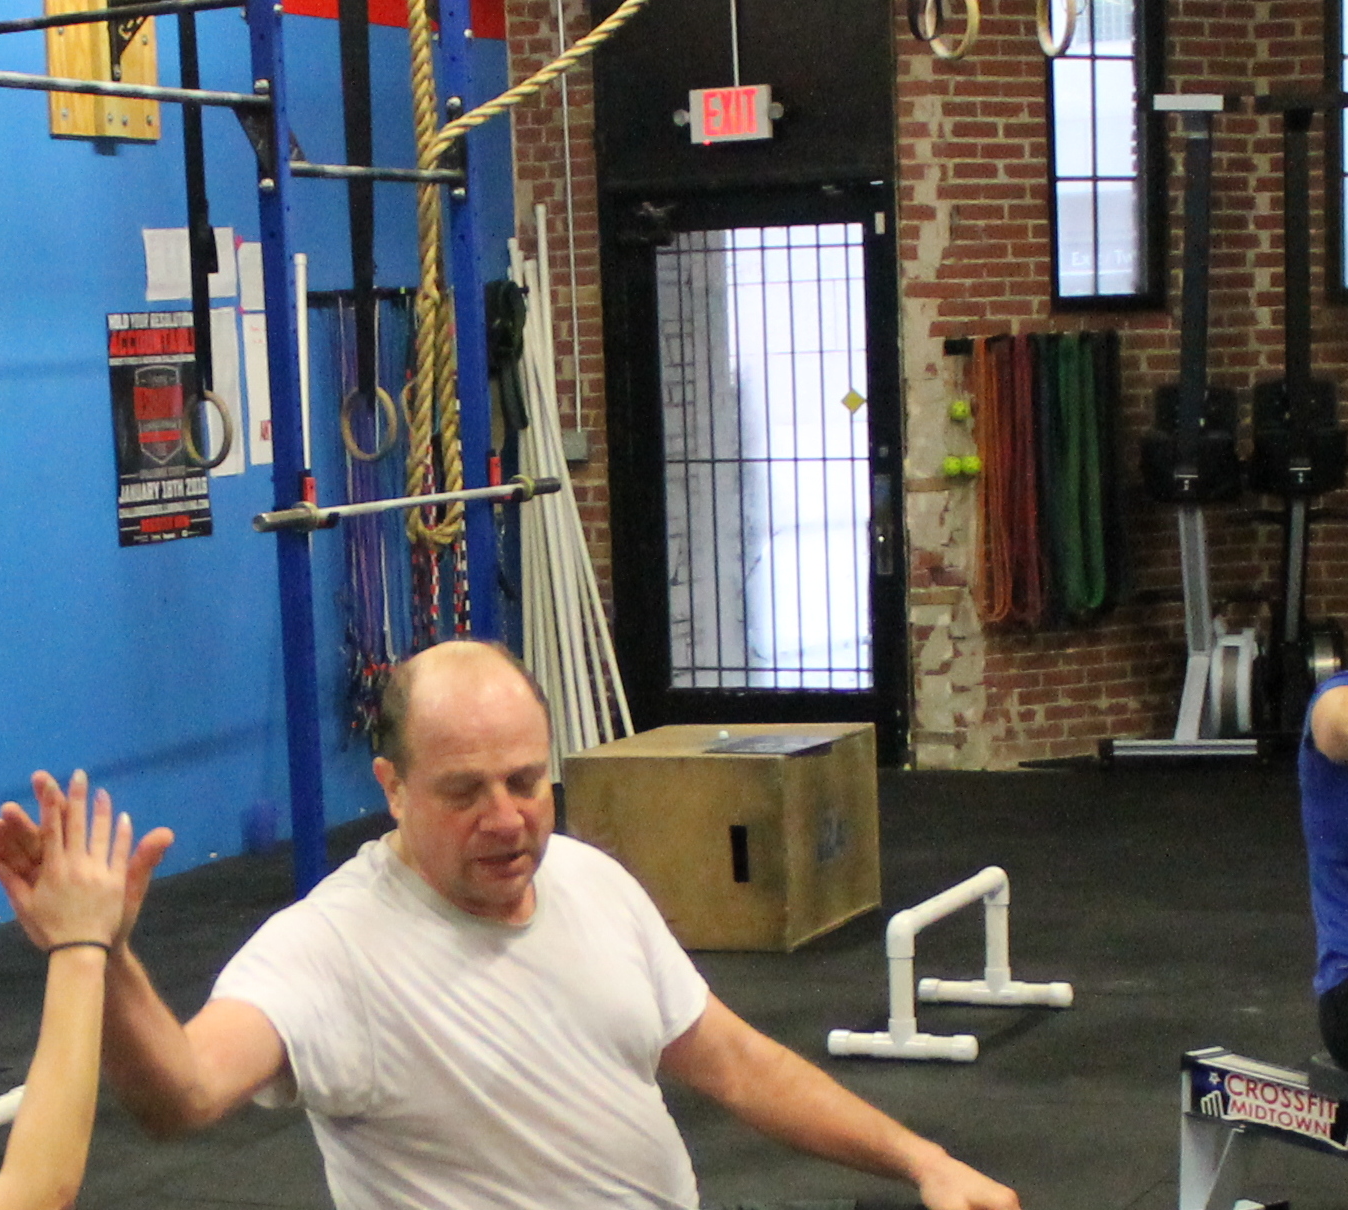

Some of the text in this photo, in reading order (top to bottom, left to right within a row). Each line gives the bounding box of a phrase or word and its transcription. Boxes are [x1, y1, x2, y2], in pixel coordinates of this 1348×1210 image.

[703, 88, 758, 136] EXIT
[119, 481, 160, 503] JANUARY
[1227, 1074, 1338, 1120] CROSSFIT
[1231, 1100, 1329, 1137] MIDTOWN
